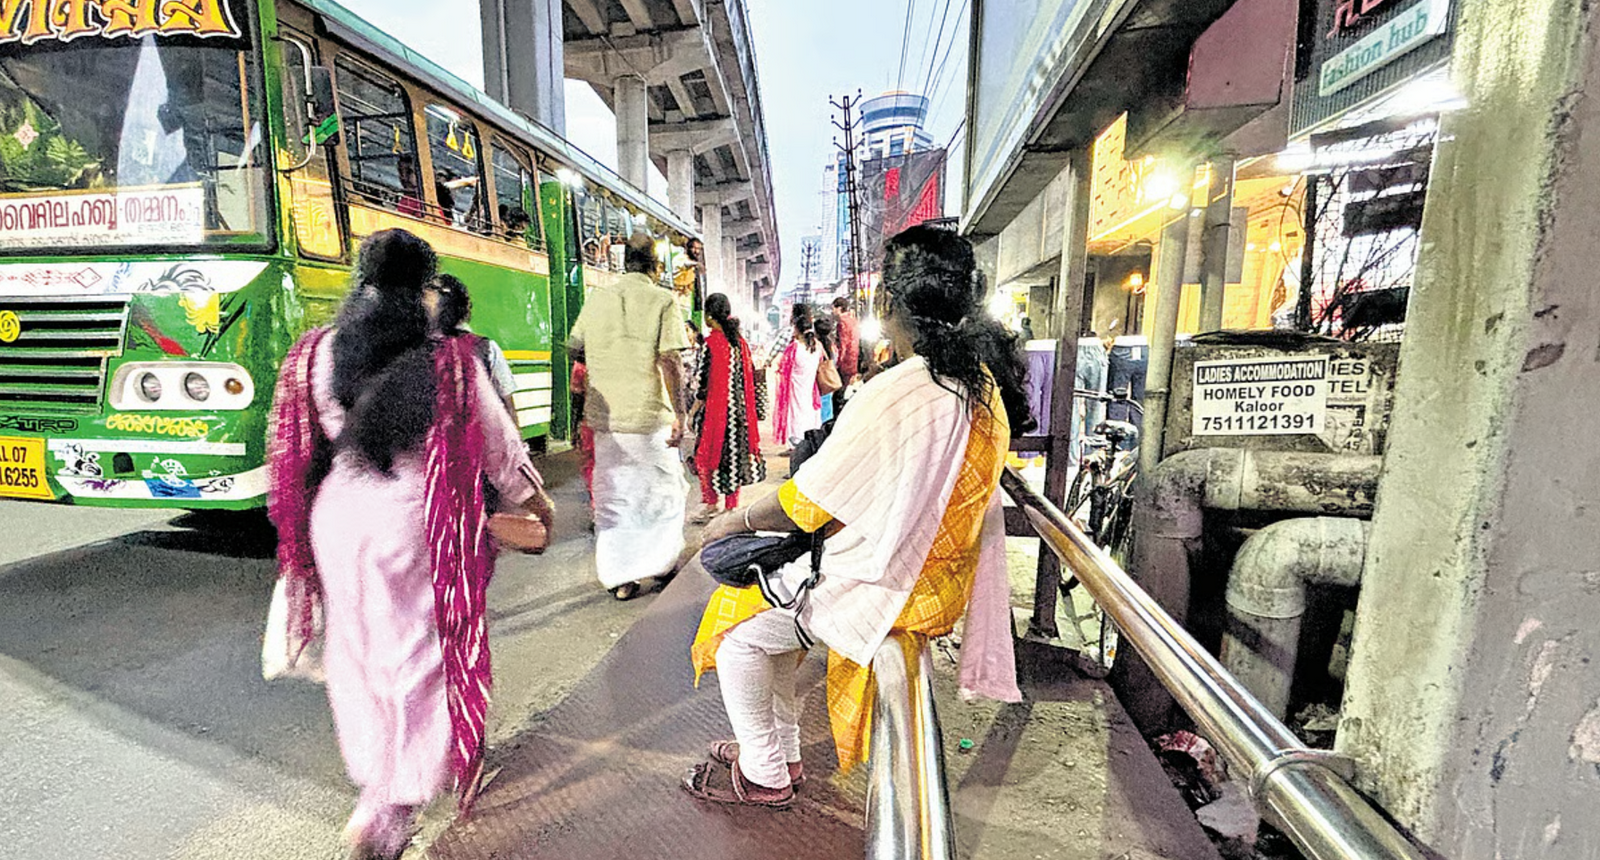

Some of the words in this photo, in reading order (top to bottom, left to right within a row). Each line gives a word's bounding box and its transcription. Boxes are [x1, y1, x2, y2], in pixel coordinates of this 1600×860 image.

[1322, 40, 1383, 88] fashion
[1386, 9, 1428, 51] hub
[1199, 365, 1233, 384] LADIES
[1233, 361, 1323, 382] ACCOMMODATION
[1329, 362, 1365, 376] IES
[1203, 386, 1266, 400] HOMELY
[1271, 384, 1315, 398] FOOD
[1327, 380, 1367, 393] TEL
[1234, 401, 1285, 413] Kaloor
[1201, 413, 1315, 431] 7511121391
